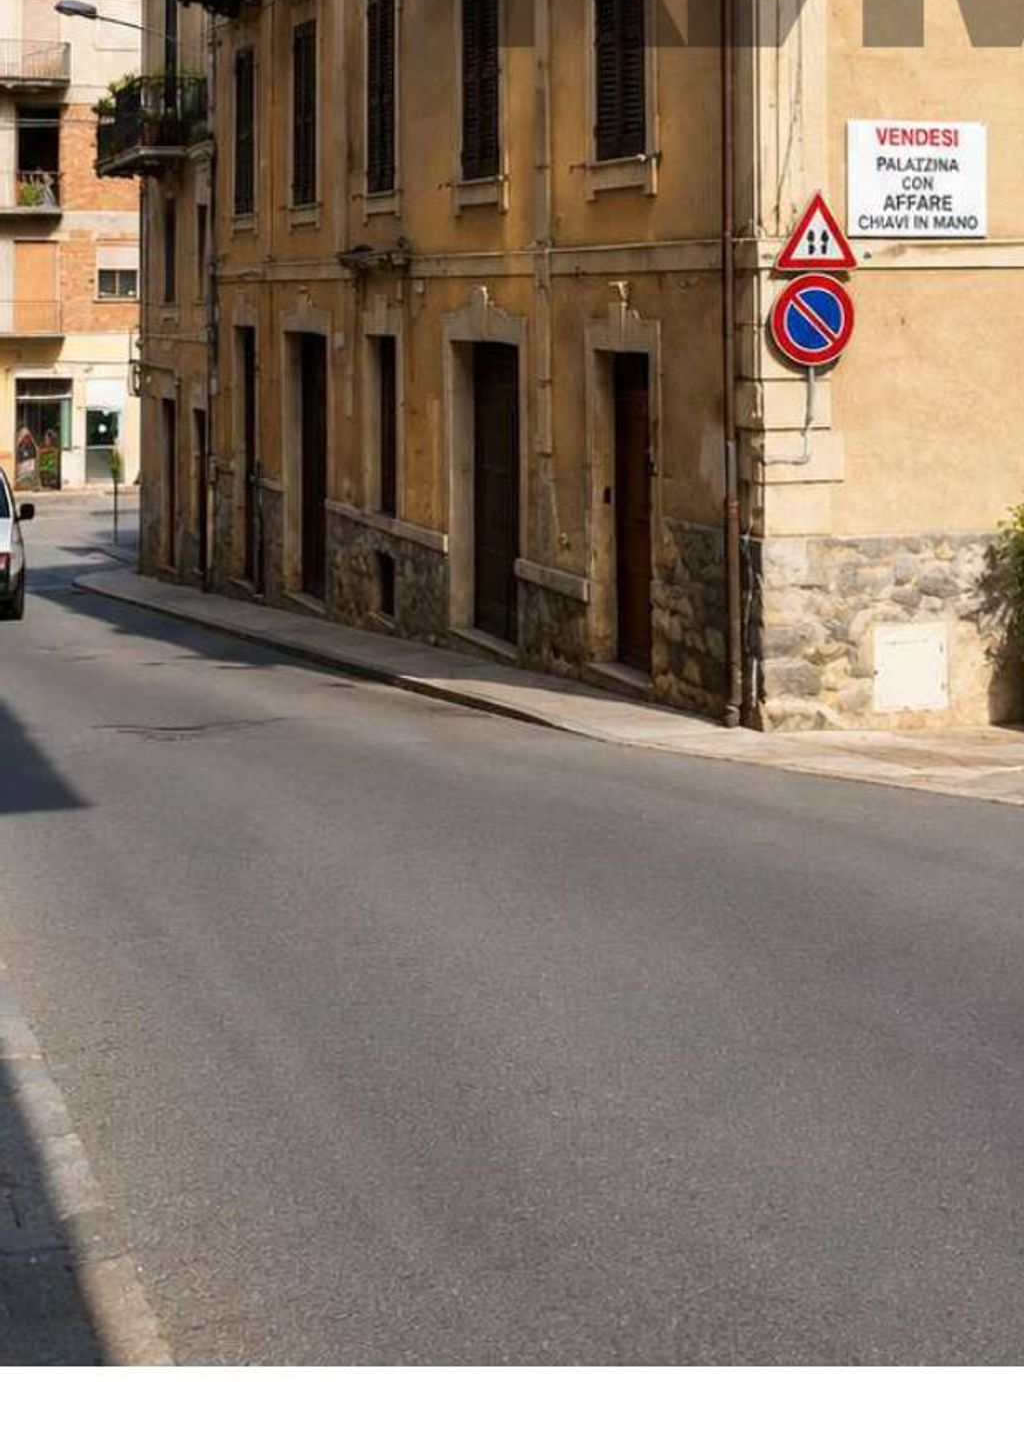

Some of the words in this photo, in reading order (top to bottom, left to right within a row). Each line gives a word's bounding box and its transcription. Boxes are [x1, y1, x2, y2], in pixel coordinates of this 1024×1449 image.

[875, 127, 959, 147] VENDESI
[901, 176, 934, 190] CON
[883, 194, 953, 211] AFFARE
[858, 214, 909, 230] CHIAVI
[913, 215, 929, 229] IN
[932, 215, 979, 230] MANO
